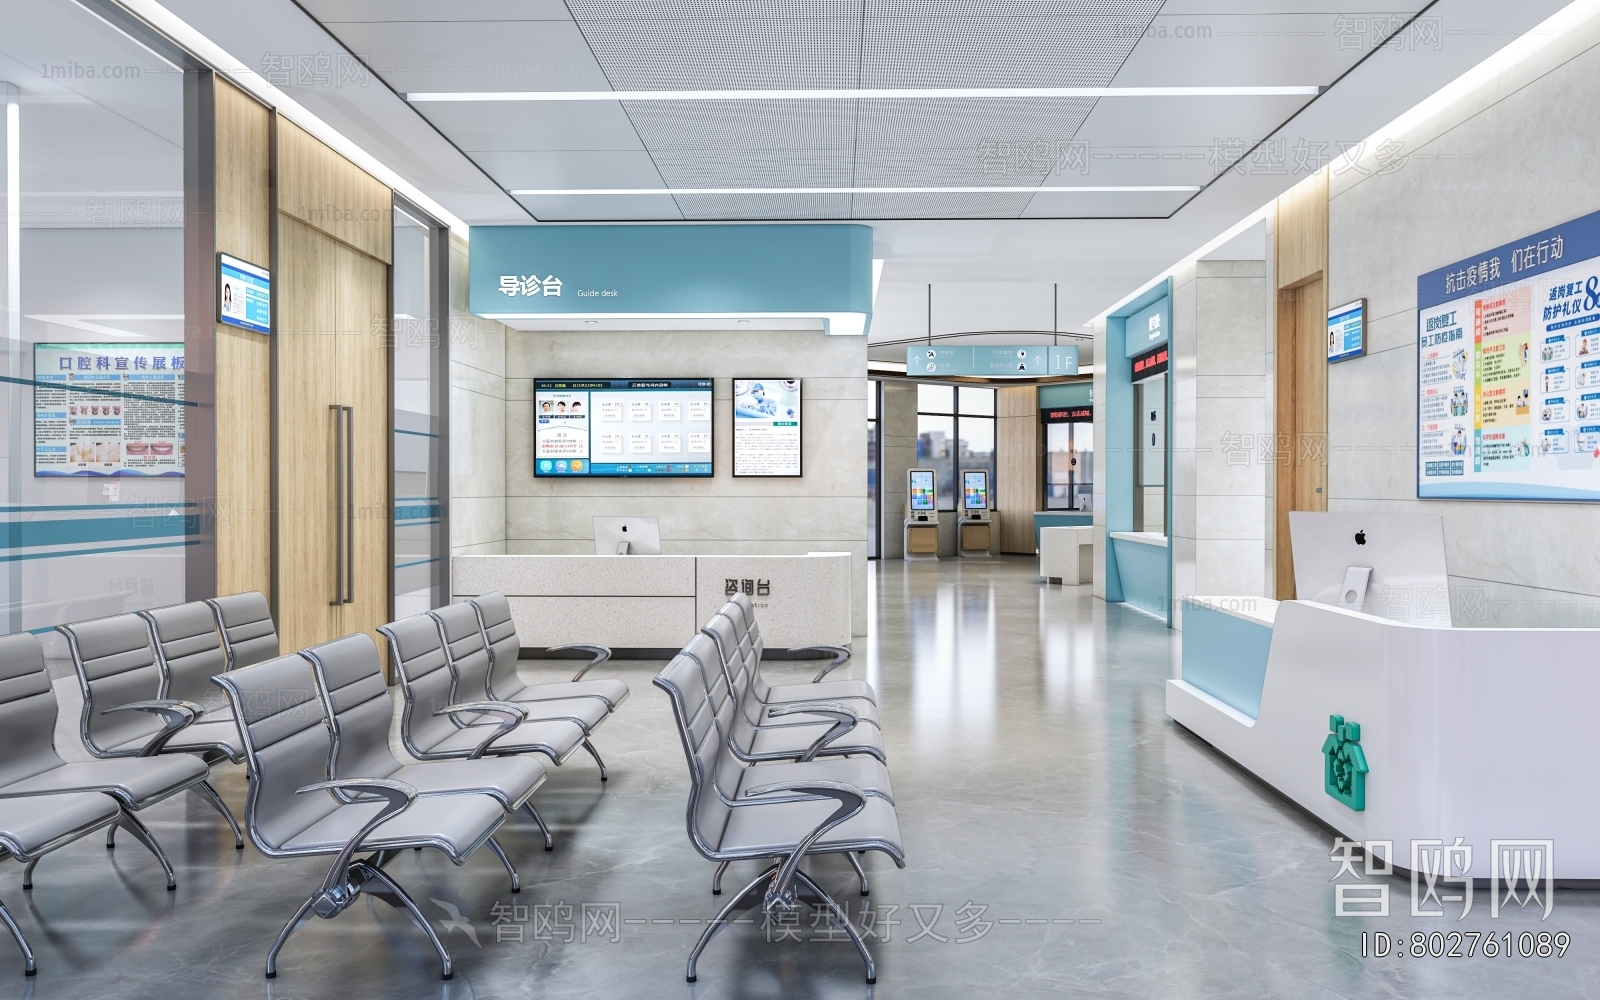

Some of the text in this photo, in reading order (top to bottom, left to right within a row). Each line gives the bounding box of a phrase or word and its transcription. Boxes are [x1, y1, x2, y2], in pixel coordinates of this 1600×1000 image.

[1445, 234, 1564, 294] 抗击疫情我 们在行动
[498, 274, 563, 297] 导诊台
[577, 288, 618, 298] Guide desk
[1543, 298, 1582, 321] 防护礼仪
[59, 356, 185, 371] 口腔科宣传展板
[725, 578, 770, 596] 咨询台
